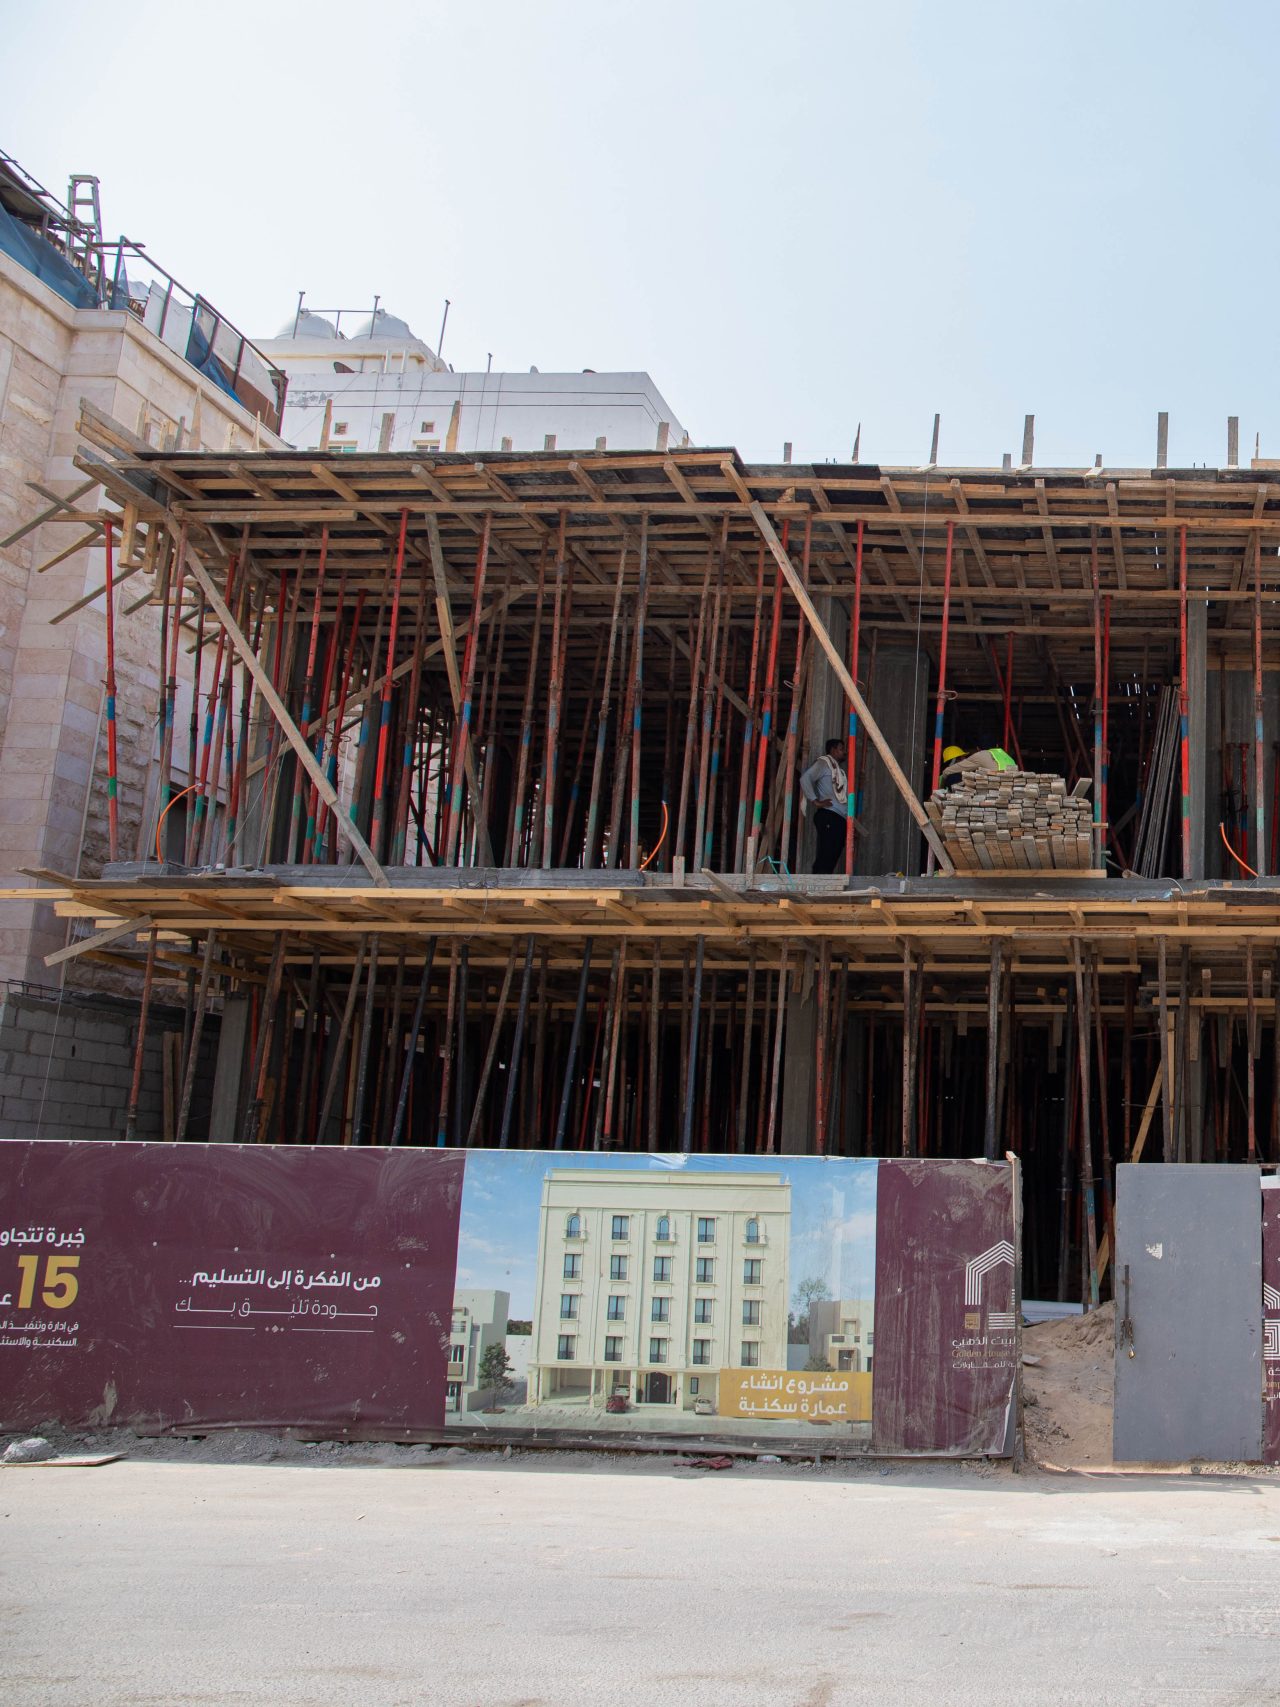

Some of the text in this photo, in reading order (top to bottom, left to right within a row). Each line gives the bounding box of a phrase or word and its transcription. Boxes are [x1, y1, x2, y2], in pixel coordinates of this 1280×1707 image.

[0, 1227, 85, 1248] خبرة تتجاو
[18, 1254, 80, 1309] 15
[267, 1270, 292, 1290] إلى
[294, 1269, 351, 1290] الفكرة
[353, 1274, 381, 1291] من
[175, 1297, 378, 1320] جودة تليق بك
[8, 1319, 46, 1332] وتنفيذ
[67, 1321, 79, 1334] في
[0, 1336, 77, 1349] السكنية والاستث
[990, 1336, 1016, 1347] لبيت
[740, 1373, 849, 1394] مشروع انشاء
[739, 1396, 848, 1417] عمارة سكنية
